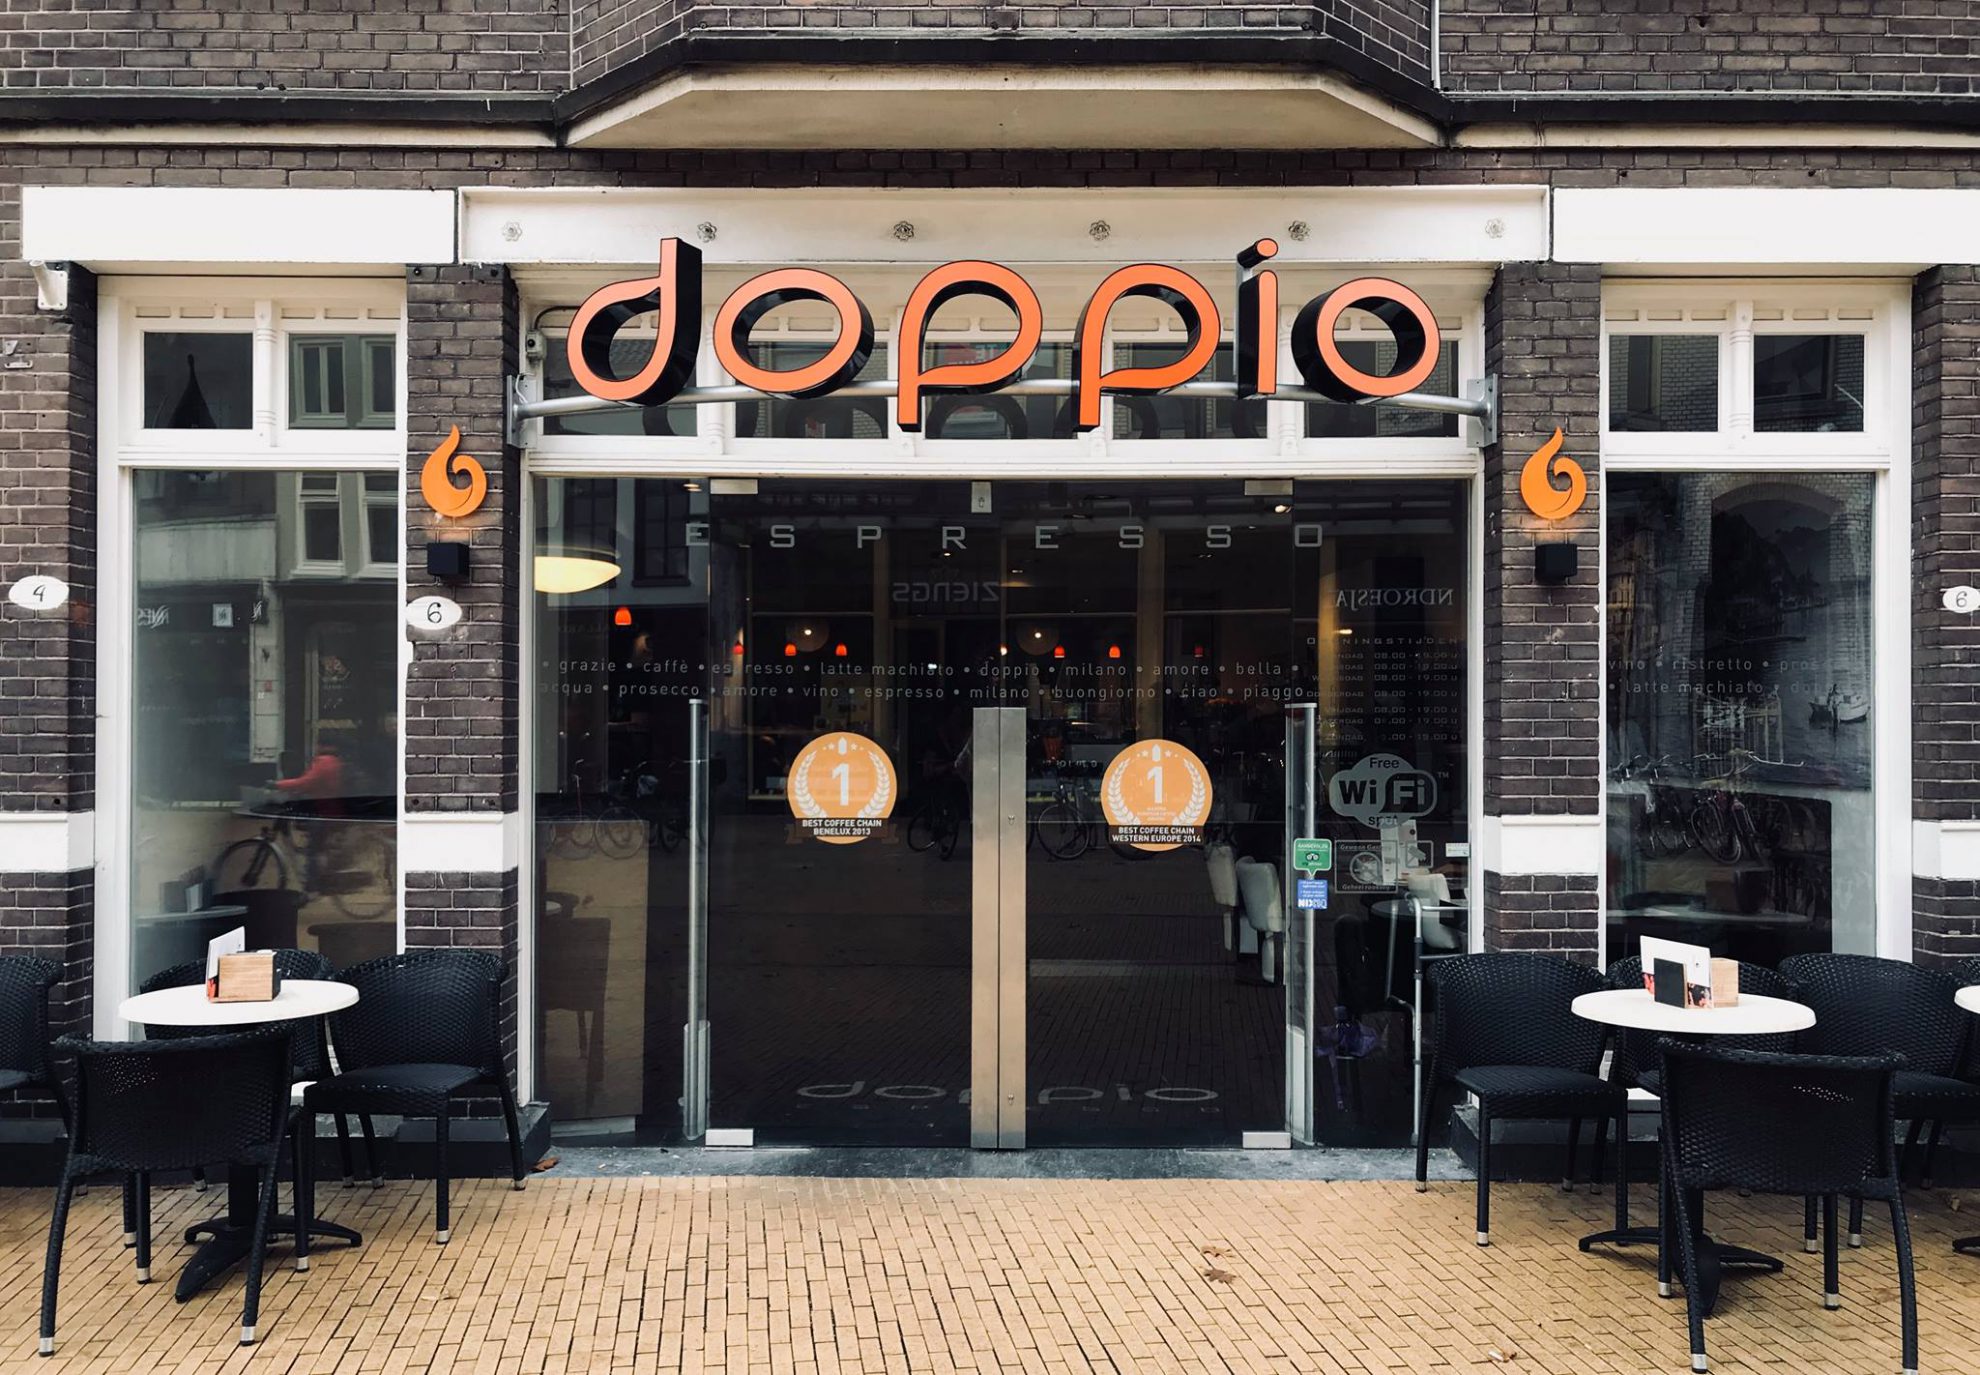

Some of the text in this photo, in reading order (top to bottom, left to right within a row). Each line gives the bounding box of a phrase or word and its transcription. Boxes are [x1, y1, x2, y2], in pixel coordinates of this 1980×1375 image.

[566, 236, 1441, 432] doppio
[685, 522, 1323, 549] ESPRESSO
[33, 584, 46, 602] 4
[1955, 590, 1968, 608] 6
[426, 601, 443, 624] 6
[558, 657, 617, 675] grazie
[642, 659, 689, 673] caffè
[711, 663, 794, 675] esresso
[820, 661, 863, 676] latte
[979, 661, 1040, 679] doppio
[1065, 662, 1128, 676] milano
[1152, 664, 1210, 676] amore
[1235, 661, 1282, 676] bella
[1671, 657, 1753, 670] ristretto
[619, 683, 700, 698] prosecco
[722, 685, 778, 697] amore
[802, 684, 839, 698] vino
[864, 686, 944, 700] espresso
[969, 685, 1030, 699] milano
[1054, 684, 1156, 701] buongiorno
[1181, 684, 1218, 698] ciao
[1243, 684, 1304, 701] piaggo
[1626, 679, 1670, 693] latte
[1369, 757, 1400, 769] Free
[831, 763, 850, 806] 1
[1146, 765, 1163, 804] 1
[802, 819, 882, 828] BEST COFFEE CHAIN
[813, 827, 872, 836] BENELUX 2013
[1118, 826, 1195, 835] BEST COFFEE CHAIN
[1368, 815, 1399, 830] spot
[1112, 834, 1202, 843] WESTERN EUROPE 2014
[796, 1080, 1220, 1105] dopio
